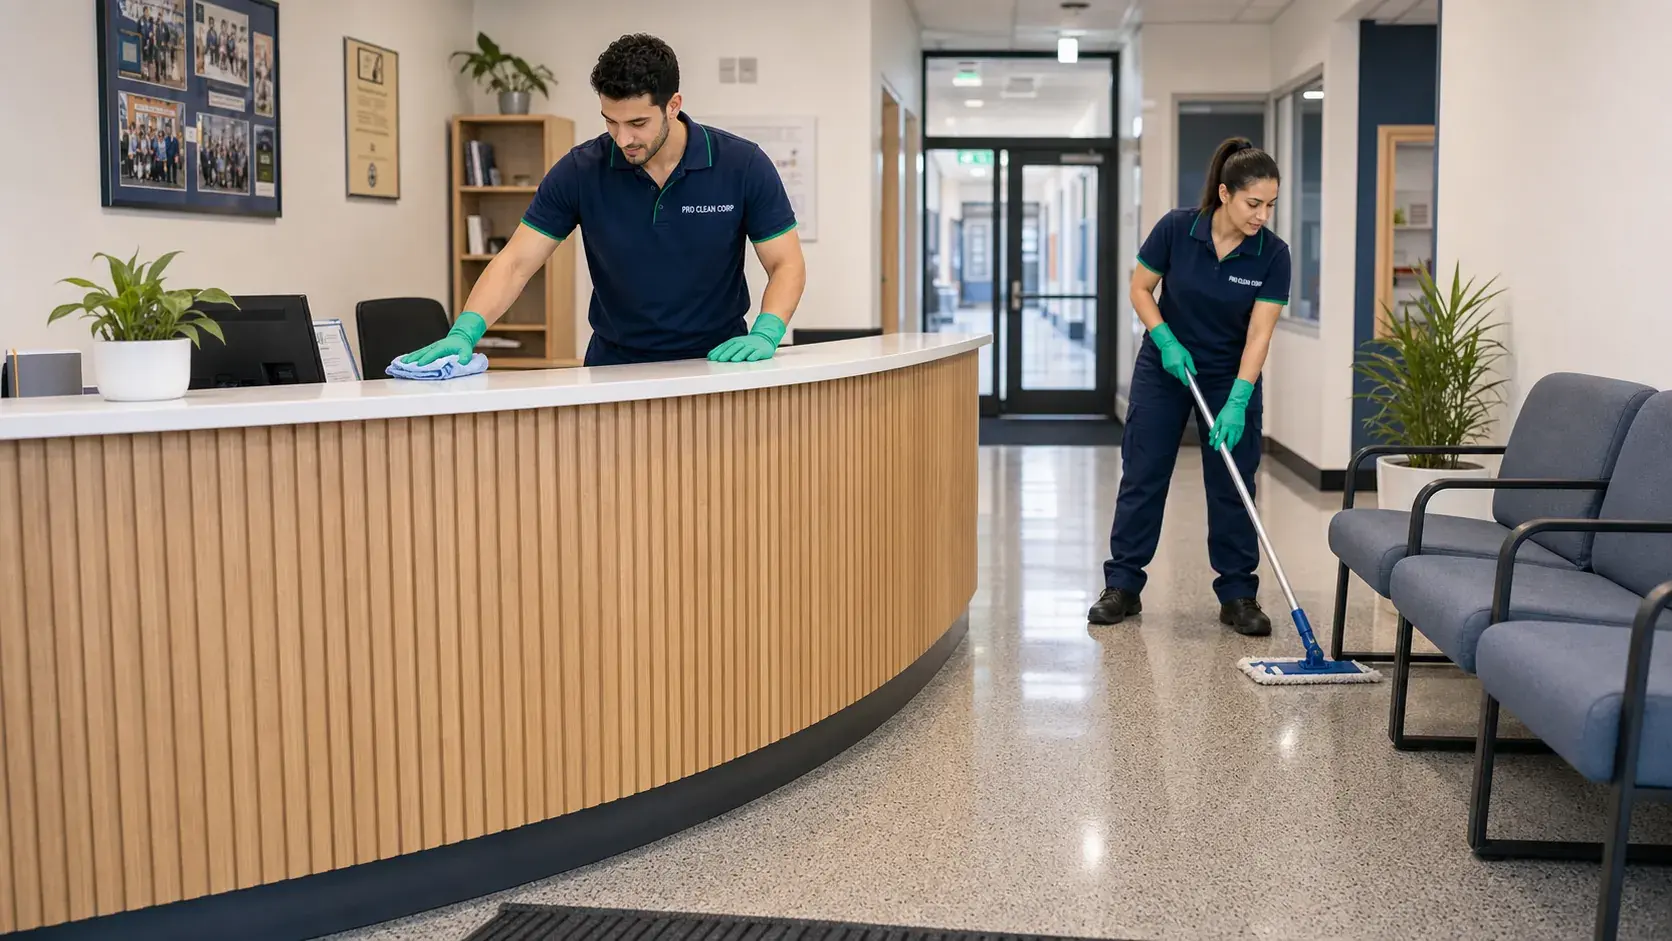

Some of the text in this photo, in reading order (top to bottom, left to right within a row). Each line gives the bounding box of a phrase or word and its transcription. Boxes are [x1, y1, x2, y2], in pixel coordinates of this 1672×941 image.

[681, 205, 695, 213] PRO
[695, 205, 716, 213] CLEAN
[1229, 275, 1238, 283] PRO
